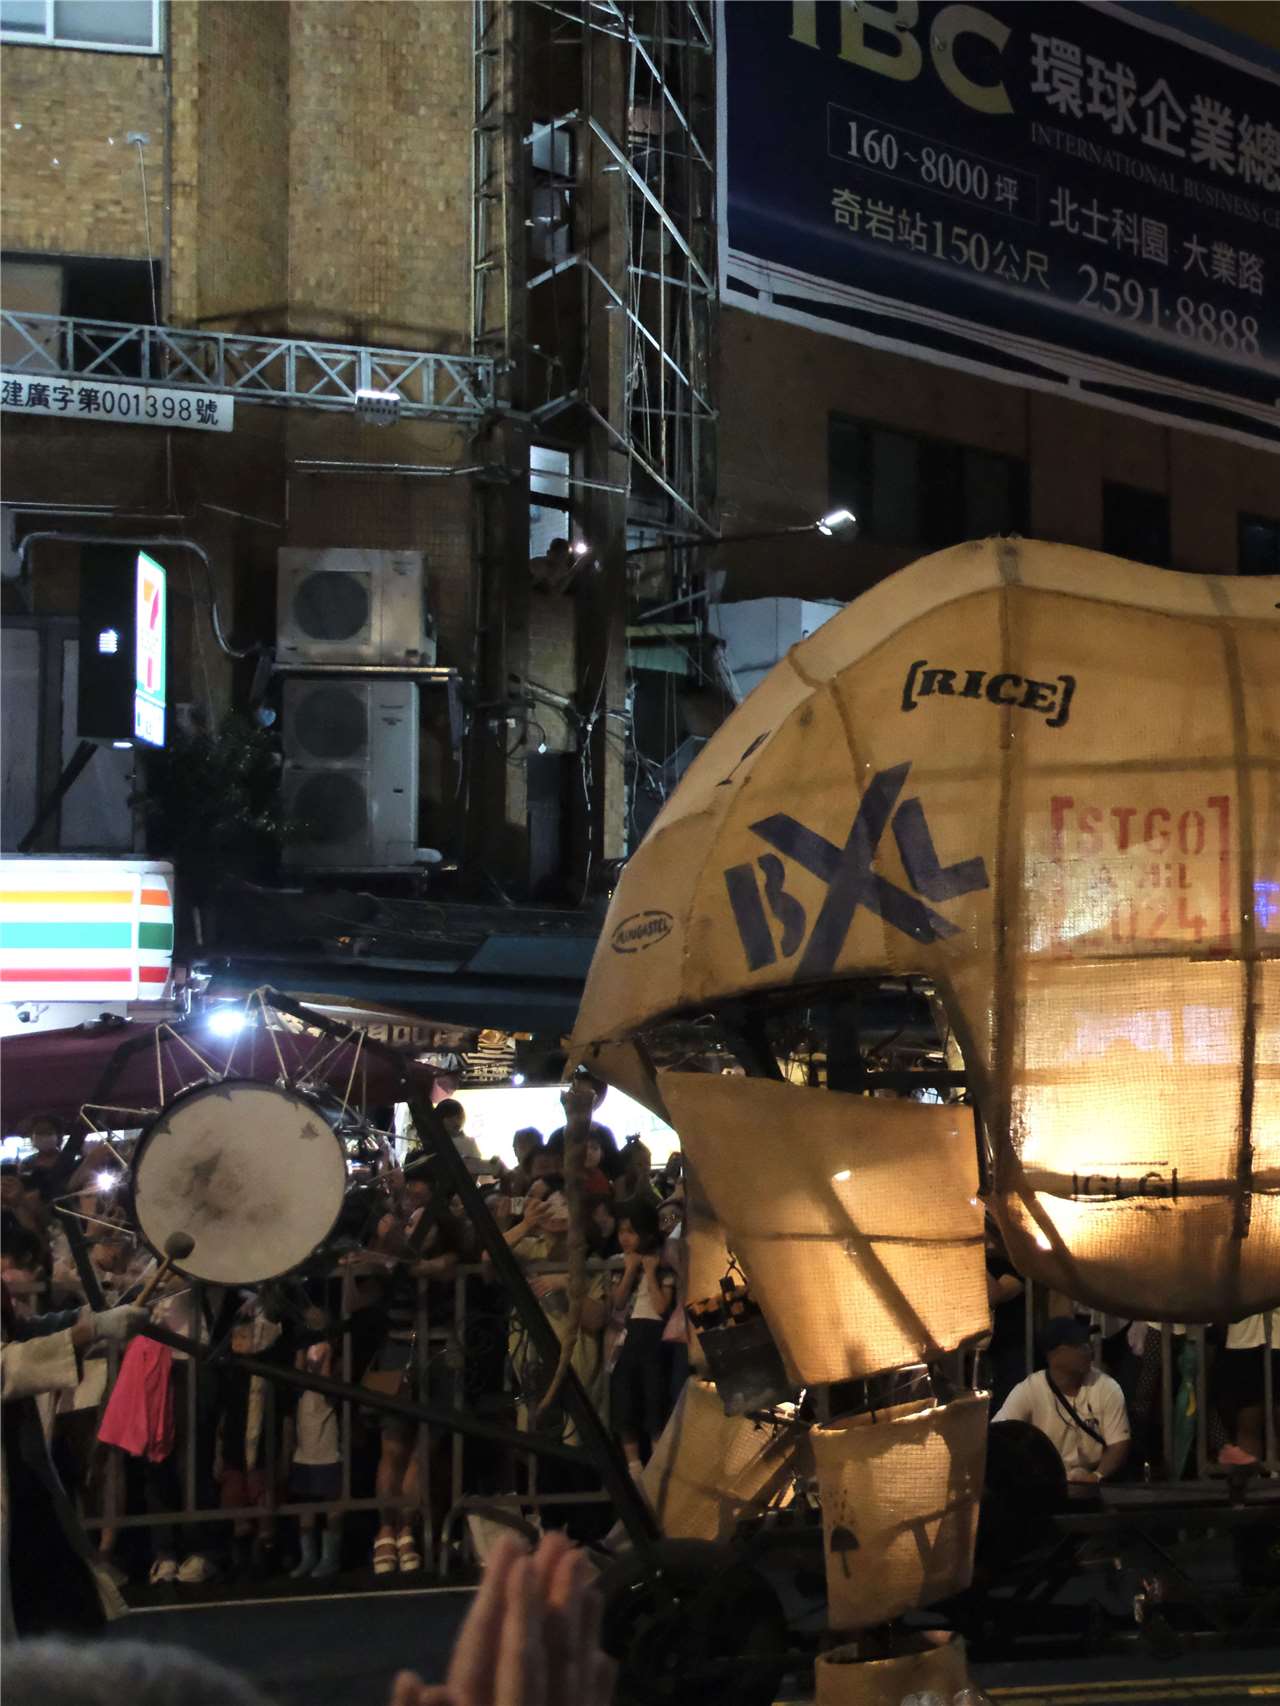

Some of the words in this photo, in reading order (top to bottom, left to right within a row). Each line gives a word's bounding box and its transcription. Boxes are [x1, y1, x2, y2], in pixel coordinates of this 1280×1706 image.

[1031, 120, 1180, 195] INTERNATIONAL
[1183, 176, 1260, 224] BUSINESS
[831, 187, 1050, 288] 奇岩站150公尺
[0, 380, 218, 426] 建廣字第001398號
[723, 761, 990, 985] BXL
